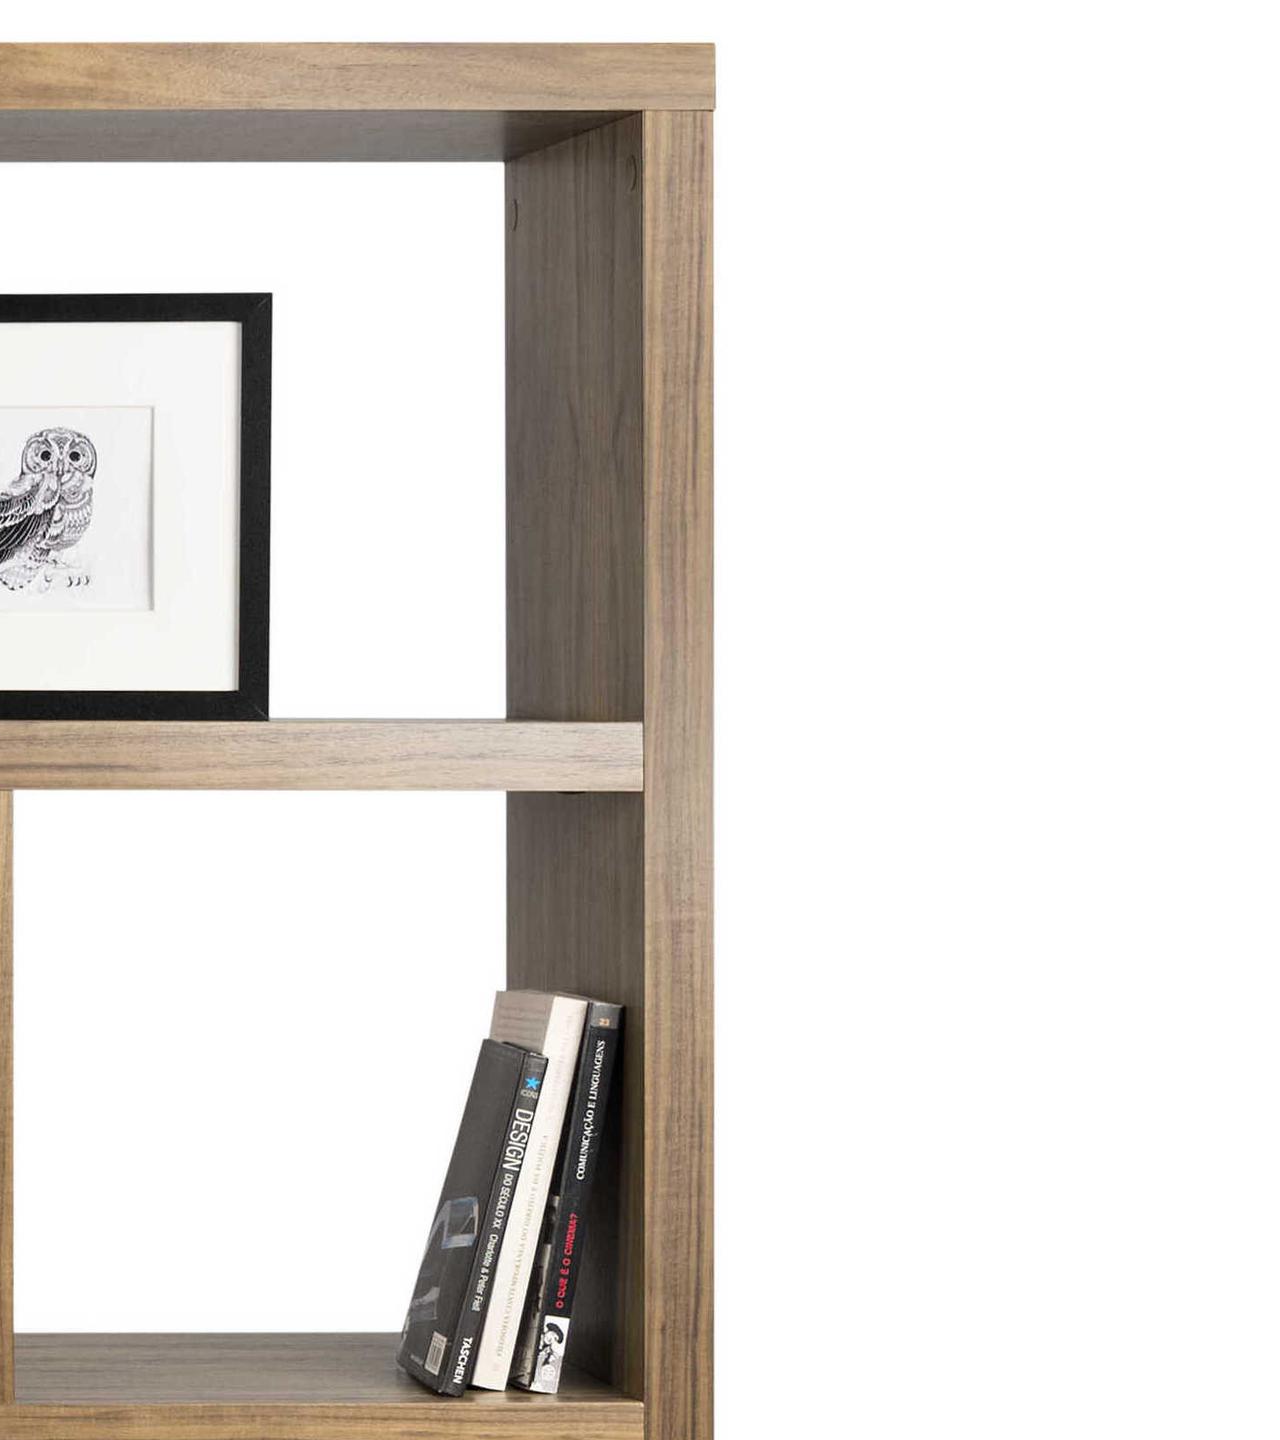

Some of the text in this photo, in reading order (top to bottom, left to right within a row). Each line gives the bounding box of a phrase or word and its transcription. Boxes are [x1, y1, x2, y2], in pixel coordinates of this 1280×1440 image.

[577, 1110, 594, 1179] COMUNICAÇÃO
[589, 1041, 605, 1099] LINGUAGENS
[503, 1109, 533, 1170] DESIGN
[492, 1173, 513, 1229] DO SÉCULO XX
[483, 1234, 498, 1265] Charlotte
[477, 1274, 488, 1294] Peter
[556, 1300, 563, 1308] O
[562, 1258, 571, 1266] O
[453, 1338, 472, 1383] TASCHEN
